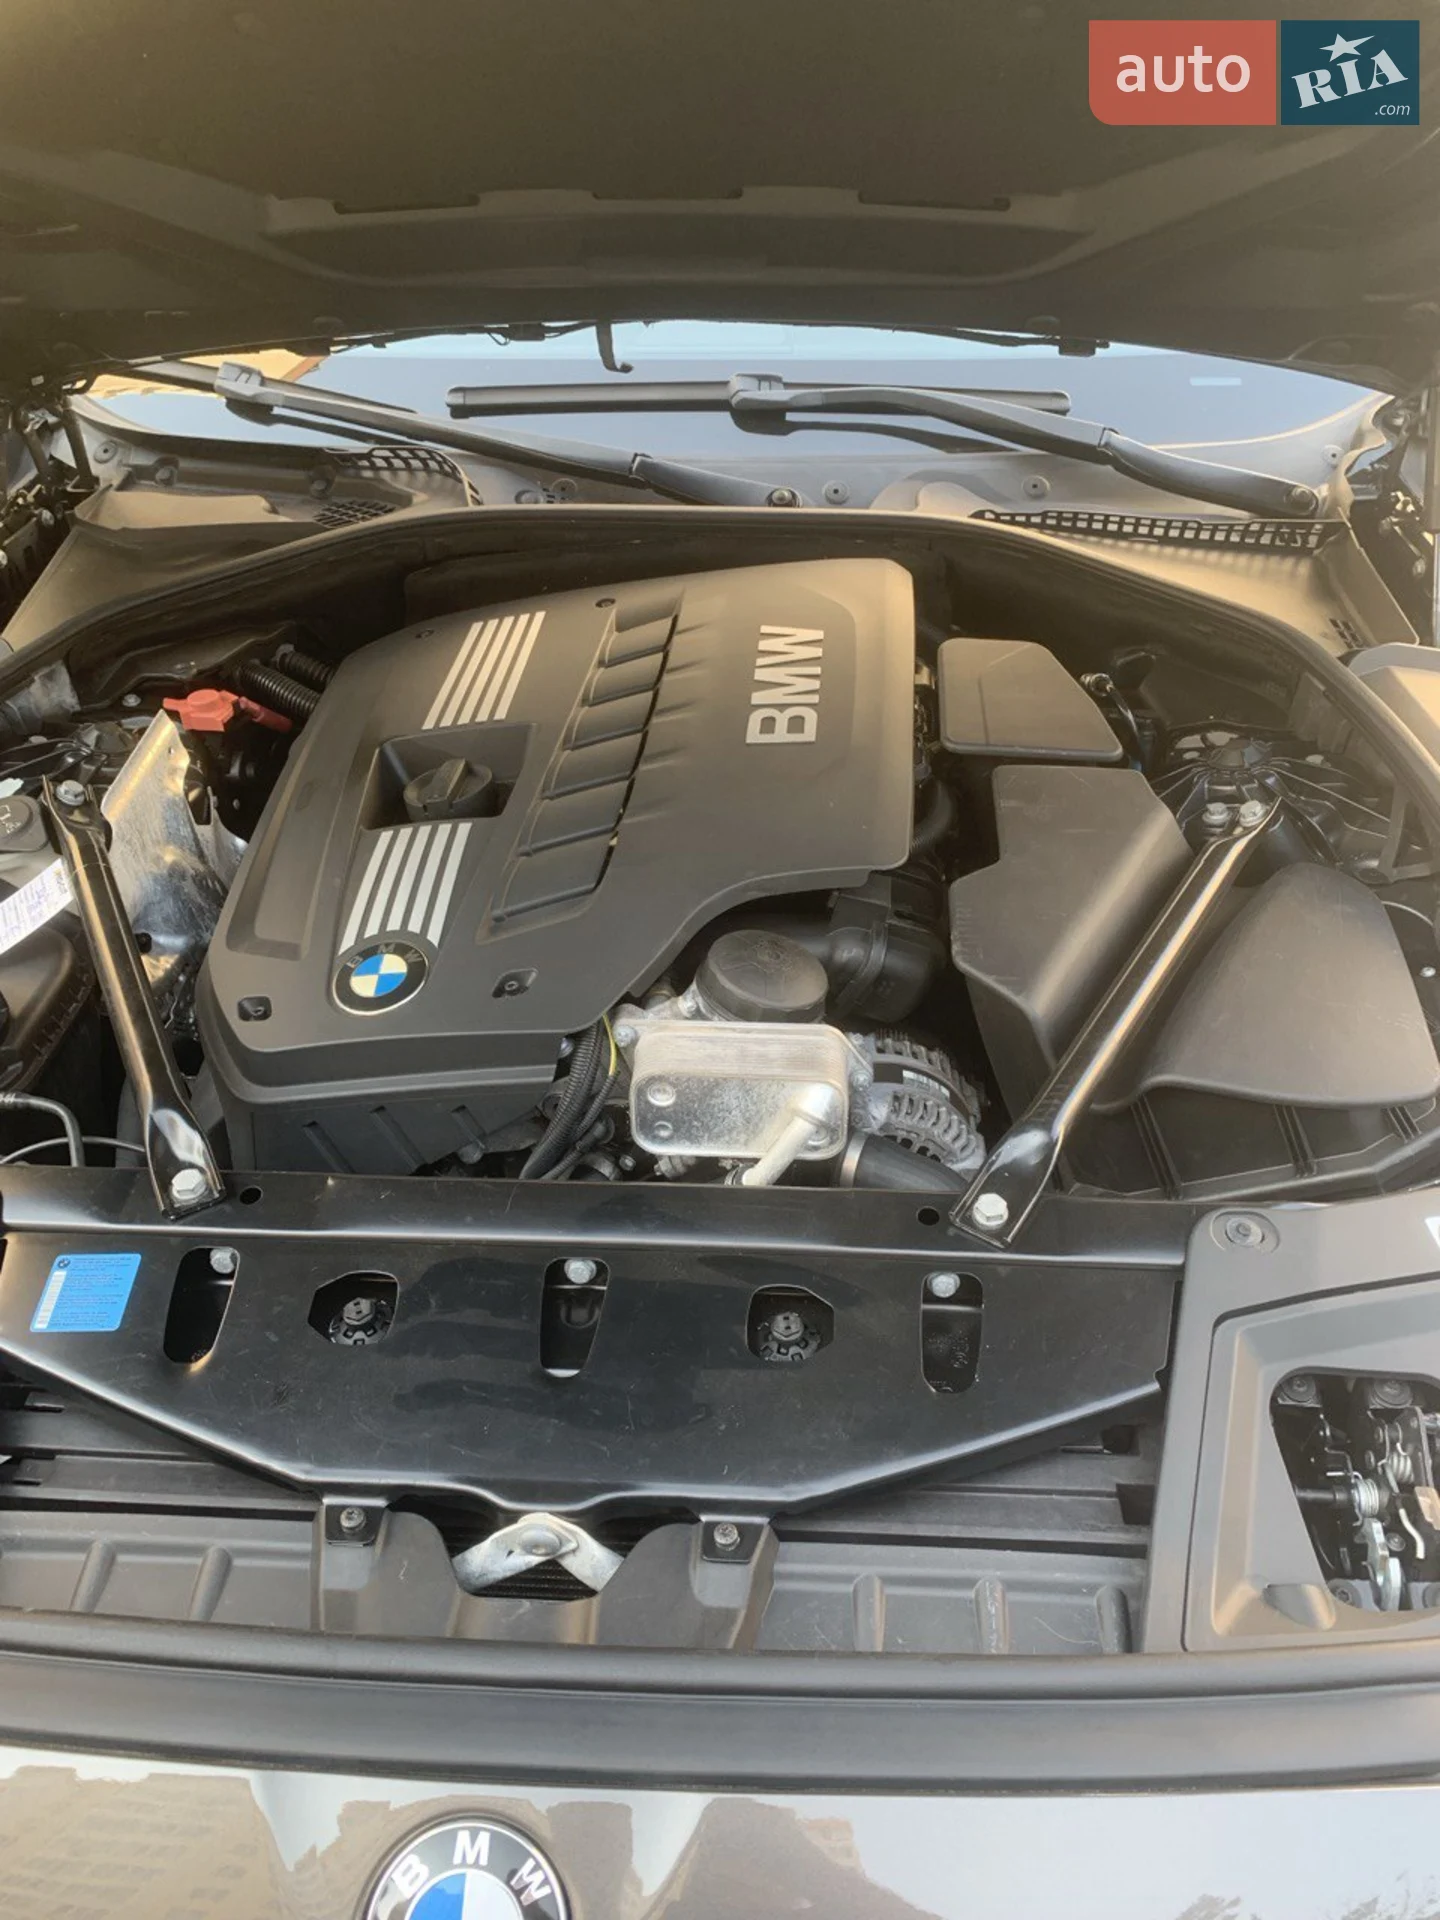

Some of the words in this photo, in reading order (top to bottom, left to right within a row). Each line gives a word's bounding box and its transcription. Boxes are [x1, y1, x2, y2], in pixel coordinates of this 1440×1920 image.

[745, 625, 825, 744] BMW
[346, 943, 423, 969] BMW
[390, 1829, 552, 1907] BMW
